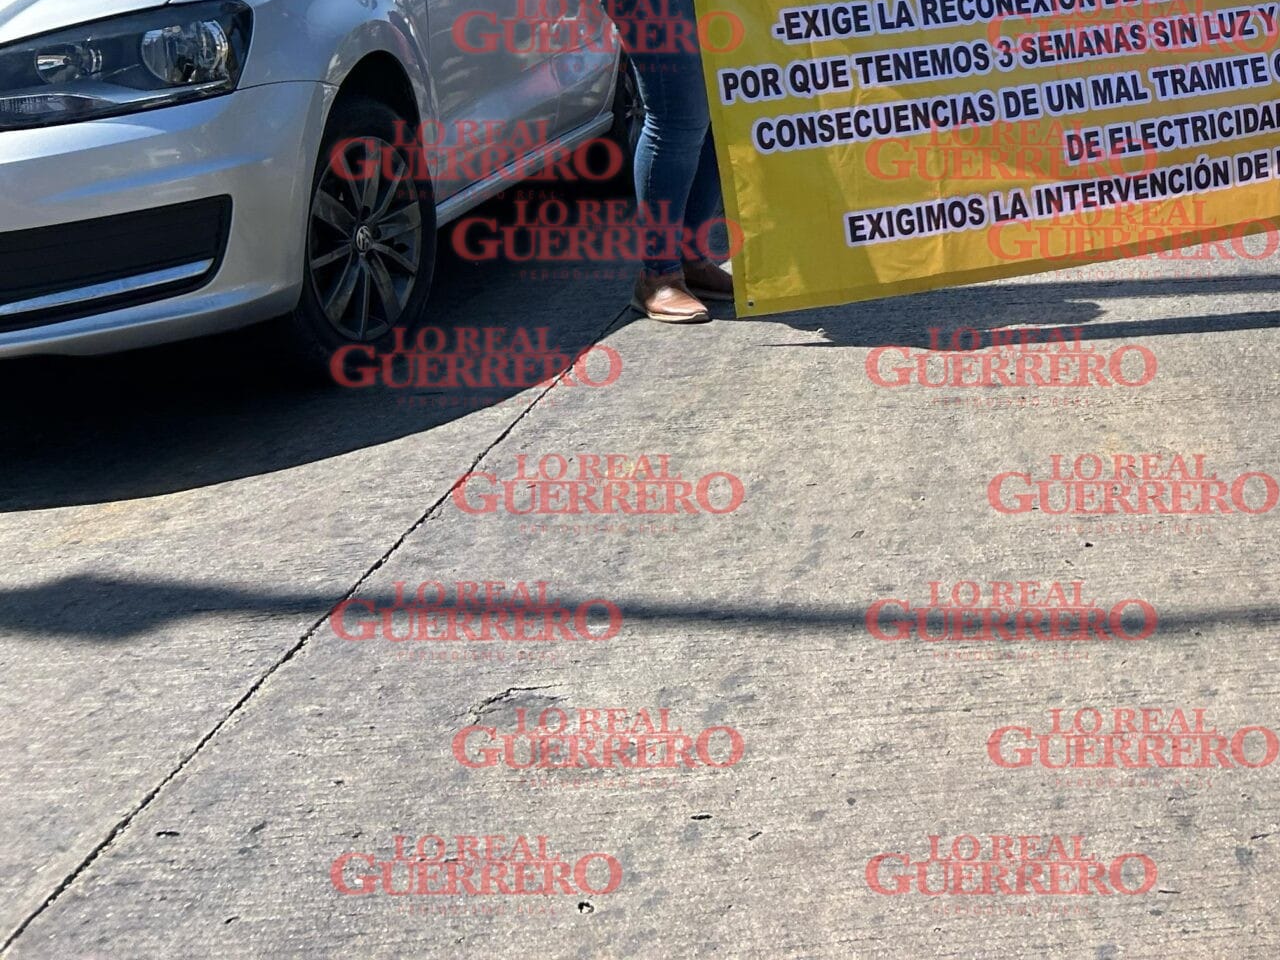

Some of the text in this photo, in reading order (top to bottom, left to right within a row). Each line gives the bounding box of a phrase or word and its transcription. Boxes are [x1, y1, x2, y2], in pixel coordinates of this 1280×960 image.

[722, 68, 782, 100] POR
[790, 60, 849, 93] QUE
[856, 43, 989, 84] TENEMOS
[997, 41, 1013, 67] 3
[1021, 23, 1146, 64] SEMANAS
[1154, 17, 1197, 47] SIN
[1204, 10, 1254, 41] LUZ
[1258, 6, 1275, 32] Y
[878, 1, 914, 29] LA
[757, 94, 995, 149] CONSECUENCIAS
[1003, 88, 1039, 118] DE
[1046, 82, 1084, 112] UN
[1092, 75, 1148, 106] MAL
[1152, 57, 1268, 96] TRAMITE
[1067, 131, 1102, 161] DE
[848, 198, 984, 242] EXIGIMOS
[993, 193, 1029, 221] LA
[1036, 157, 1229, 215] INTERVENCIÓN
[1237, 153, 1268, 182] DE
